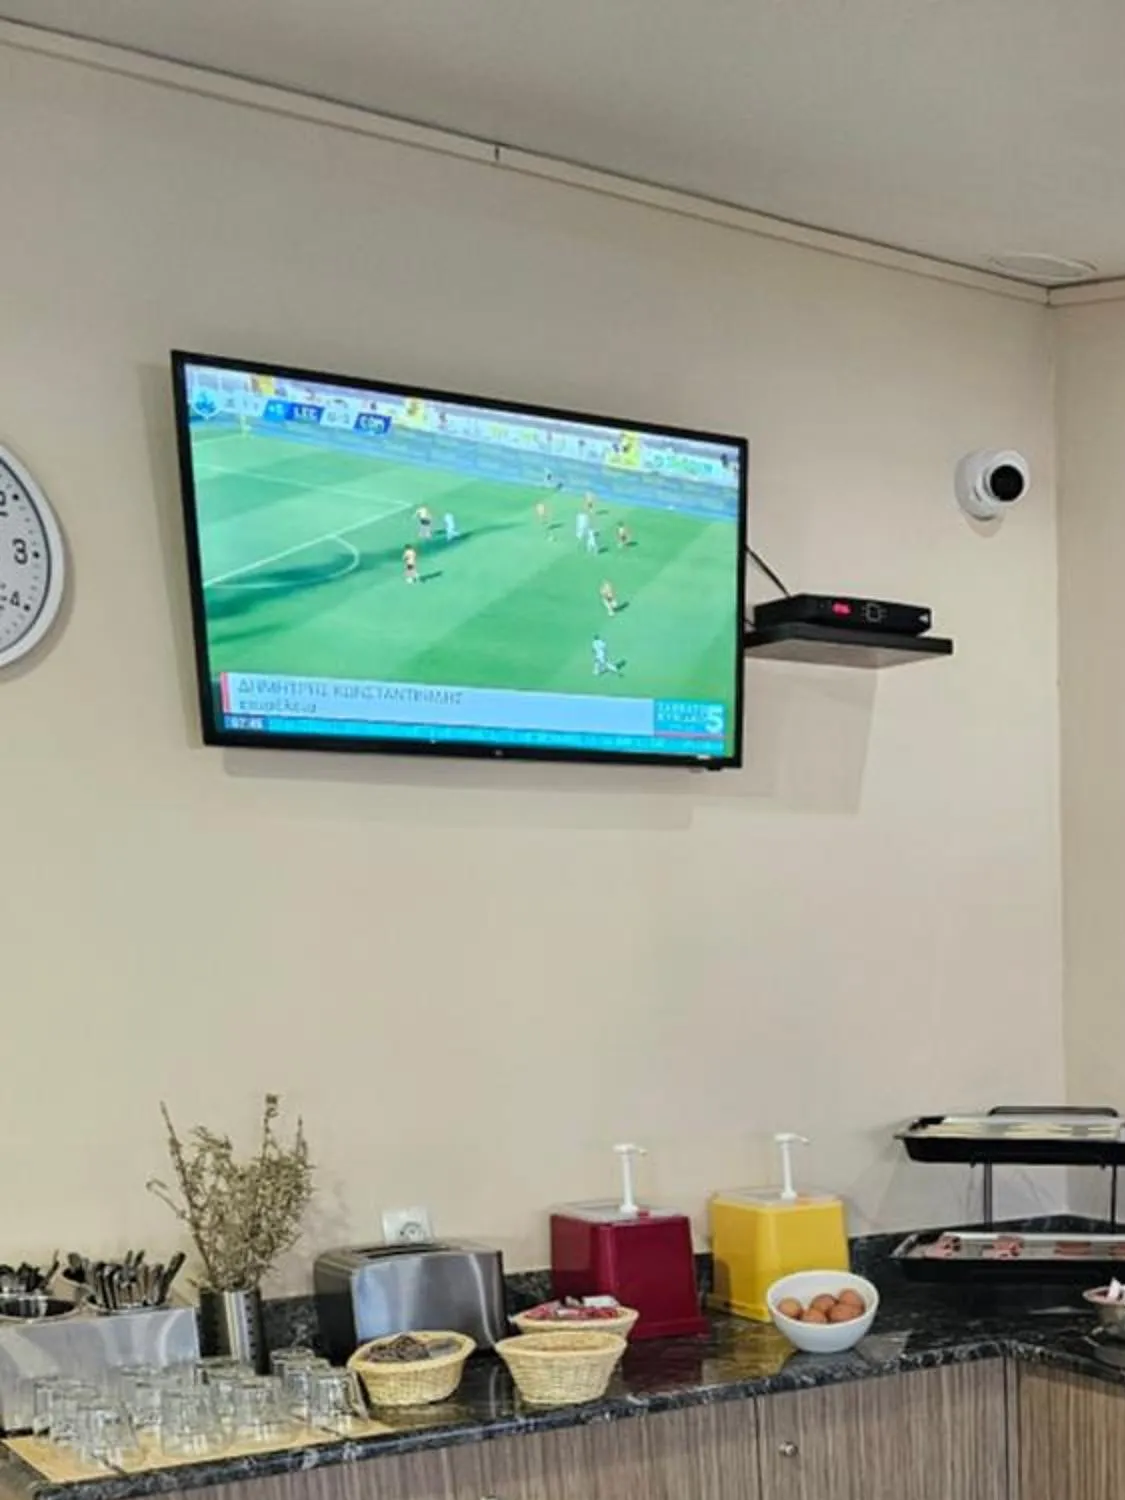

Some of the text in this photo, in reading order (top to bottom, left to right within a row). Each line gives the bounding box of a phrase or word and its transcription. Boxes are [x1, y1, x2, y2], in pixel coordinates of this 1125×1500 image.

[12, 537, 29, 565] 3
[10, 591, 20, 608] 4
[705, 704, 724, 733] 5
